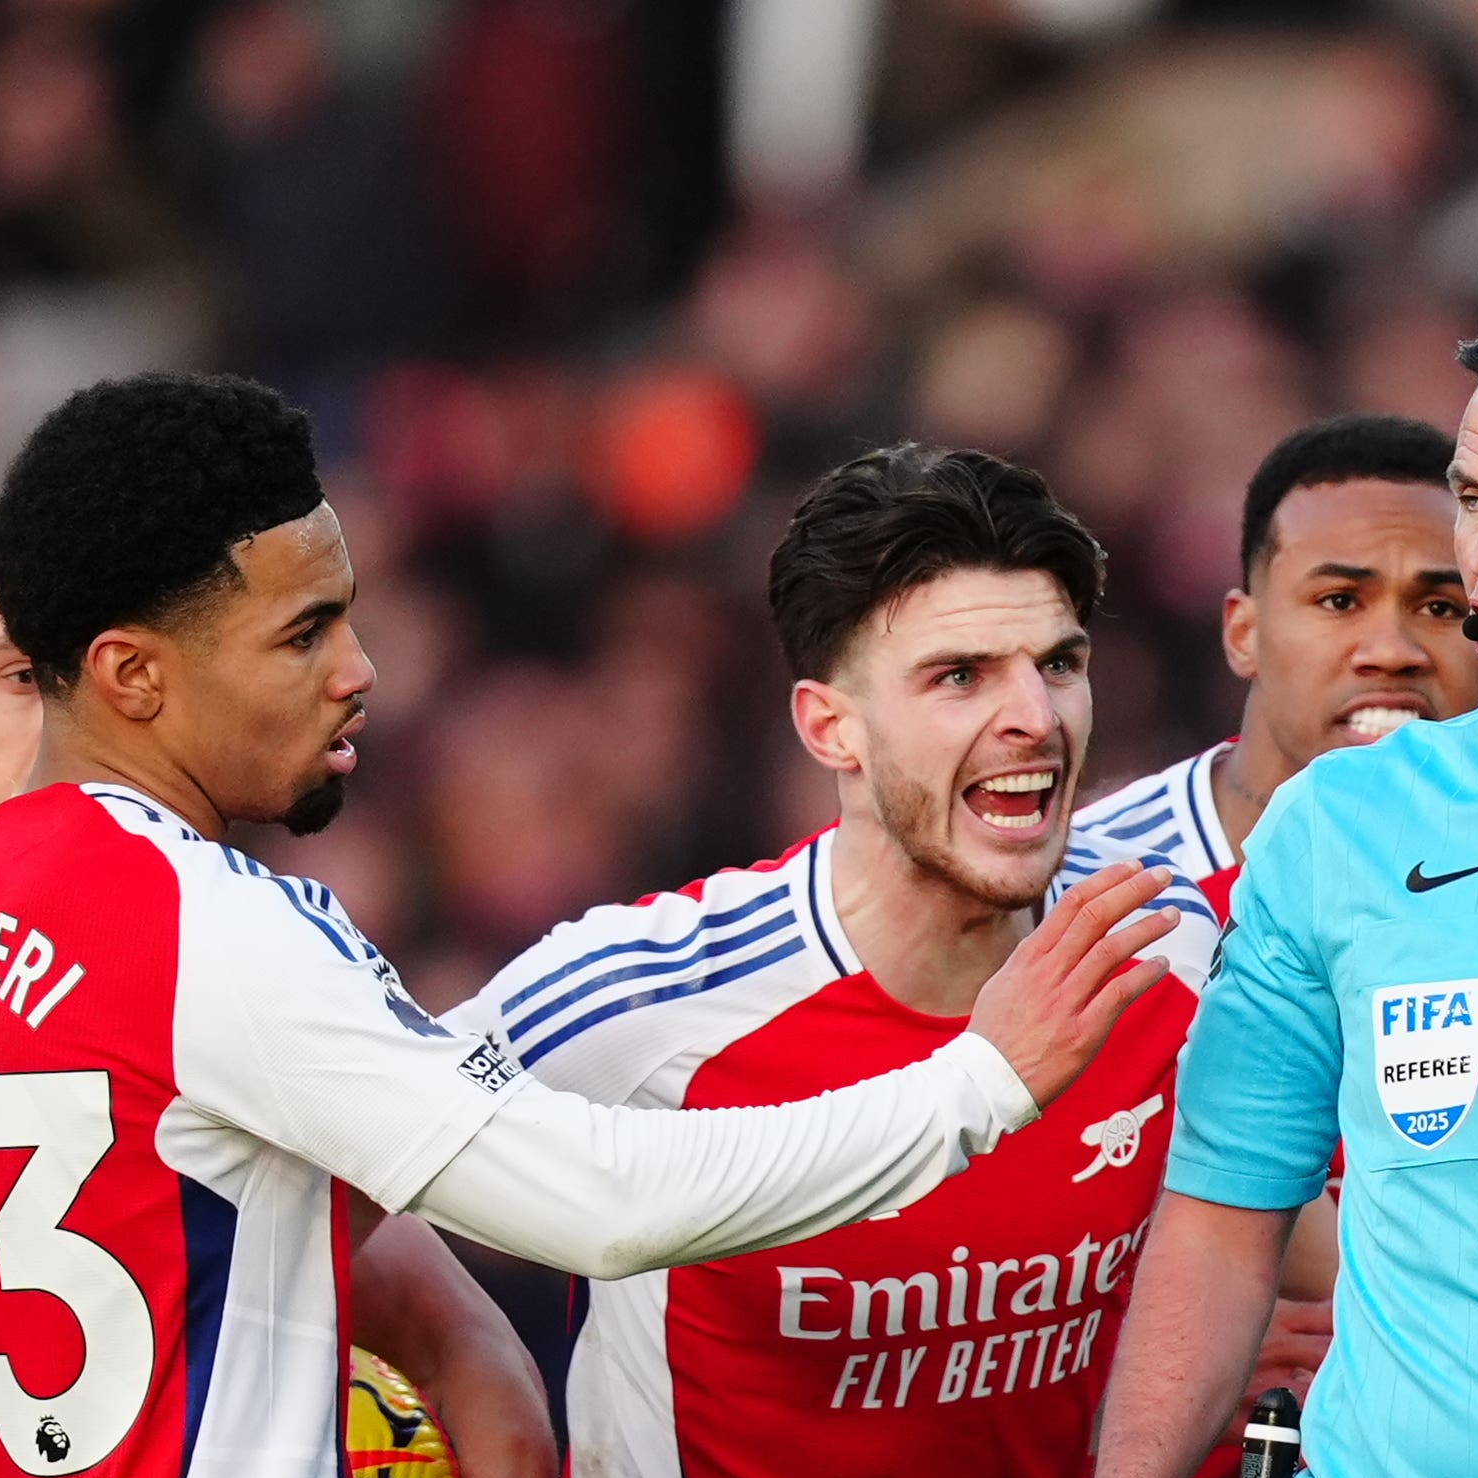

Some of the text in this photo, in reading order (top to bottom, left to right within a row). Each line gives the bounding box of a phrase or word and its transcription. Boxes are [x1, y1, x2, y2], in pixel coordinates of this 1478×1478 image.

[1382, 991, 1474, 1036] FIFA
[457, 1056, 492, 1080] No
[1384, 1055, 1471, 1084] REFEREE
[1407, 1111, 1449, 1134] 2025
[830, 1309, 1102, 1409] FLY BETTER
